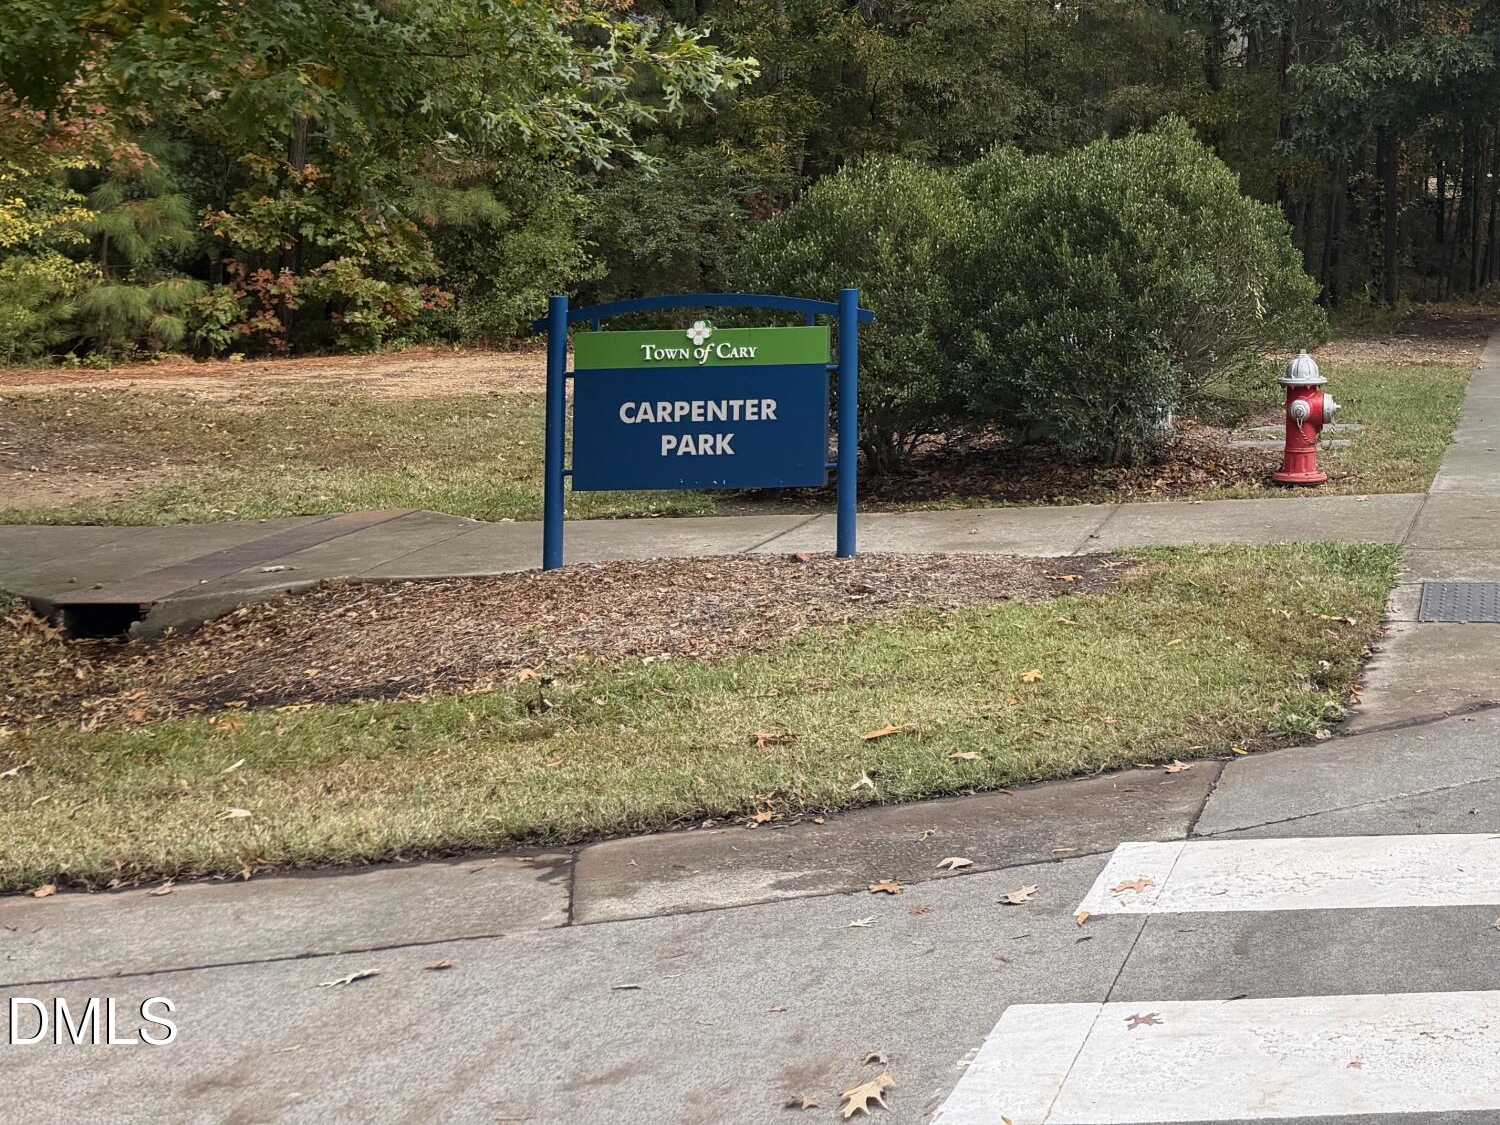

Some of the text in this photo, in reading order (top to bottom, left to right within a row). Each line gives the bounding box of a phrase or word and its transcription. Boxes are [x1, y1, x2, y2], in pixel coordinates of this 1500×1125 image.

[693, 343, 715, 365] of
[619, 398, 777, 424] CARPENTER
[661, 434, 735, 456] PARK
